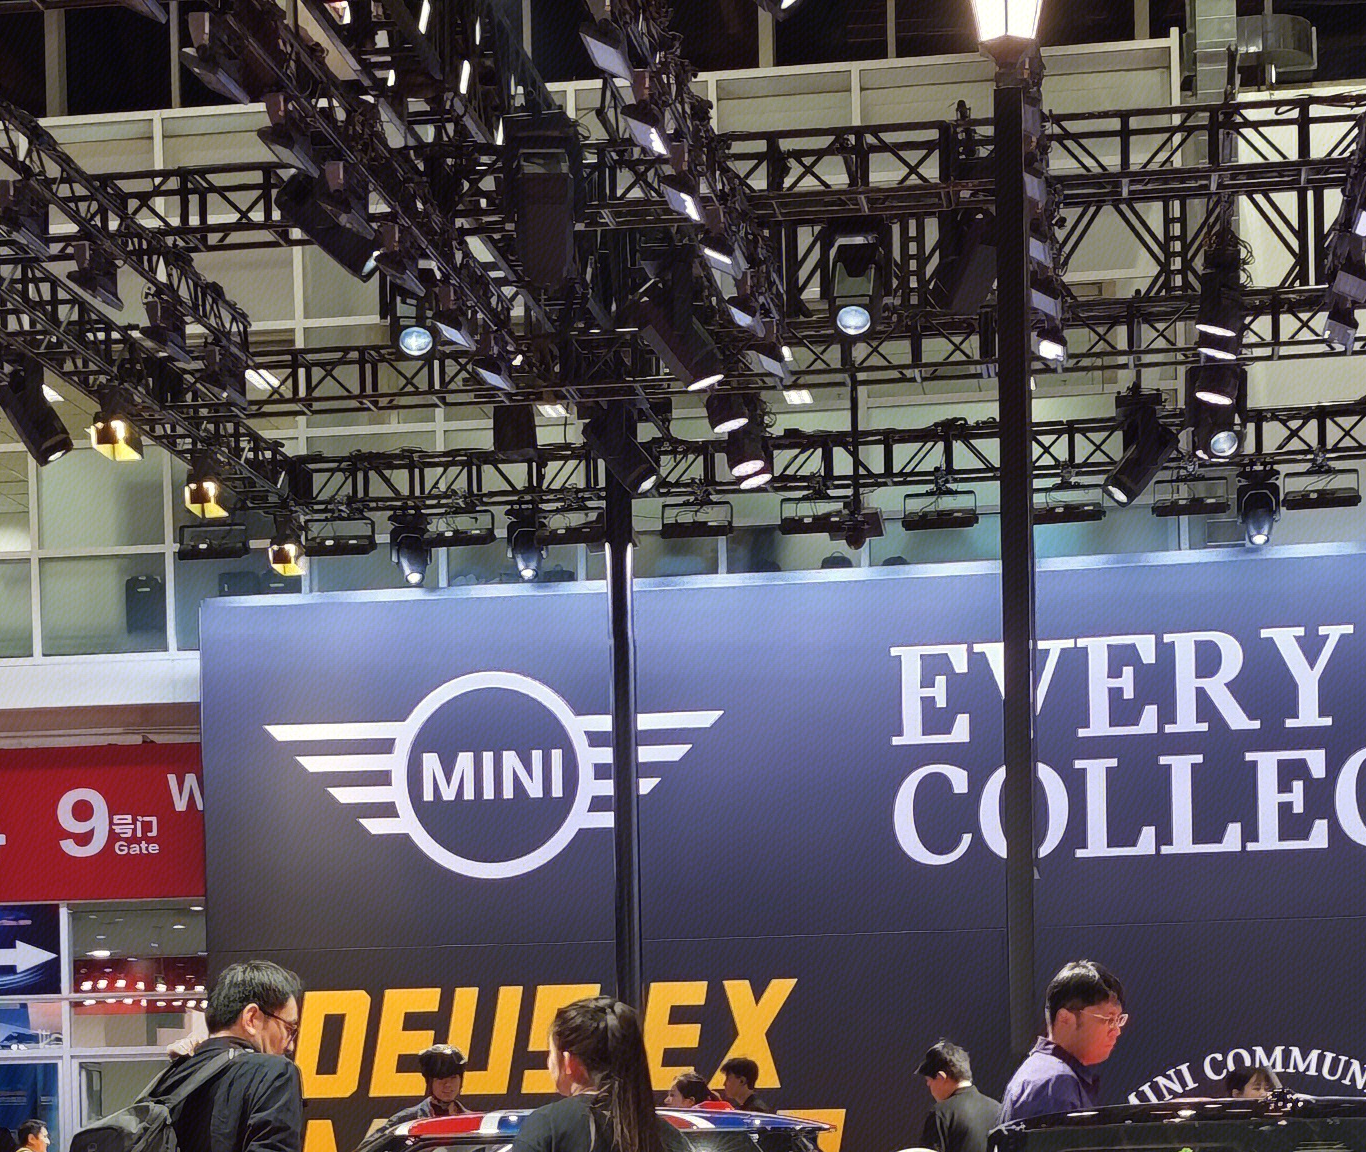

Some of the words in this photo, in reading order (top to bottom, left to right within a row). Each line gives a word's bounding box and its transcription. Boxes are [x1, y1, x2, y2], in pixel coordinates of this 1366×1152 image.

[889, 623, 1355, 747] EVERY
[421, 748, 564, 802] MINI
[114, 840, 160, 856] Gate
[643, 977, 798, 1092] EX
